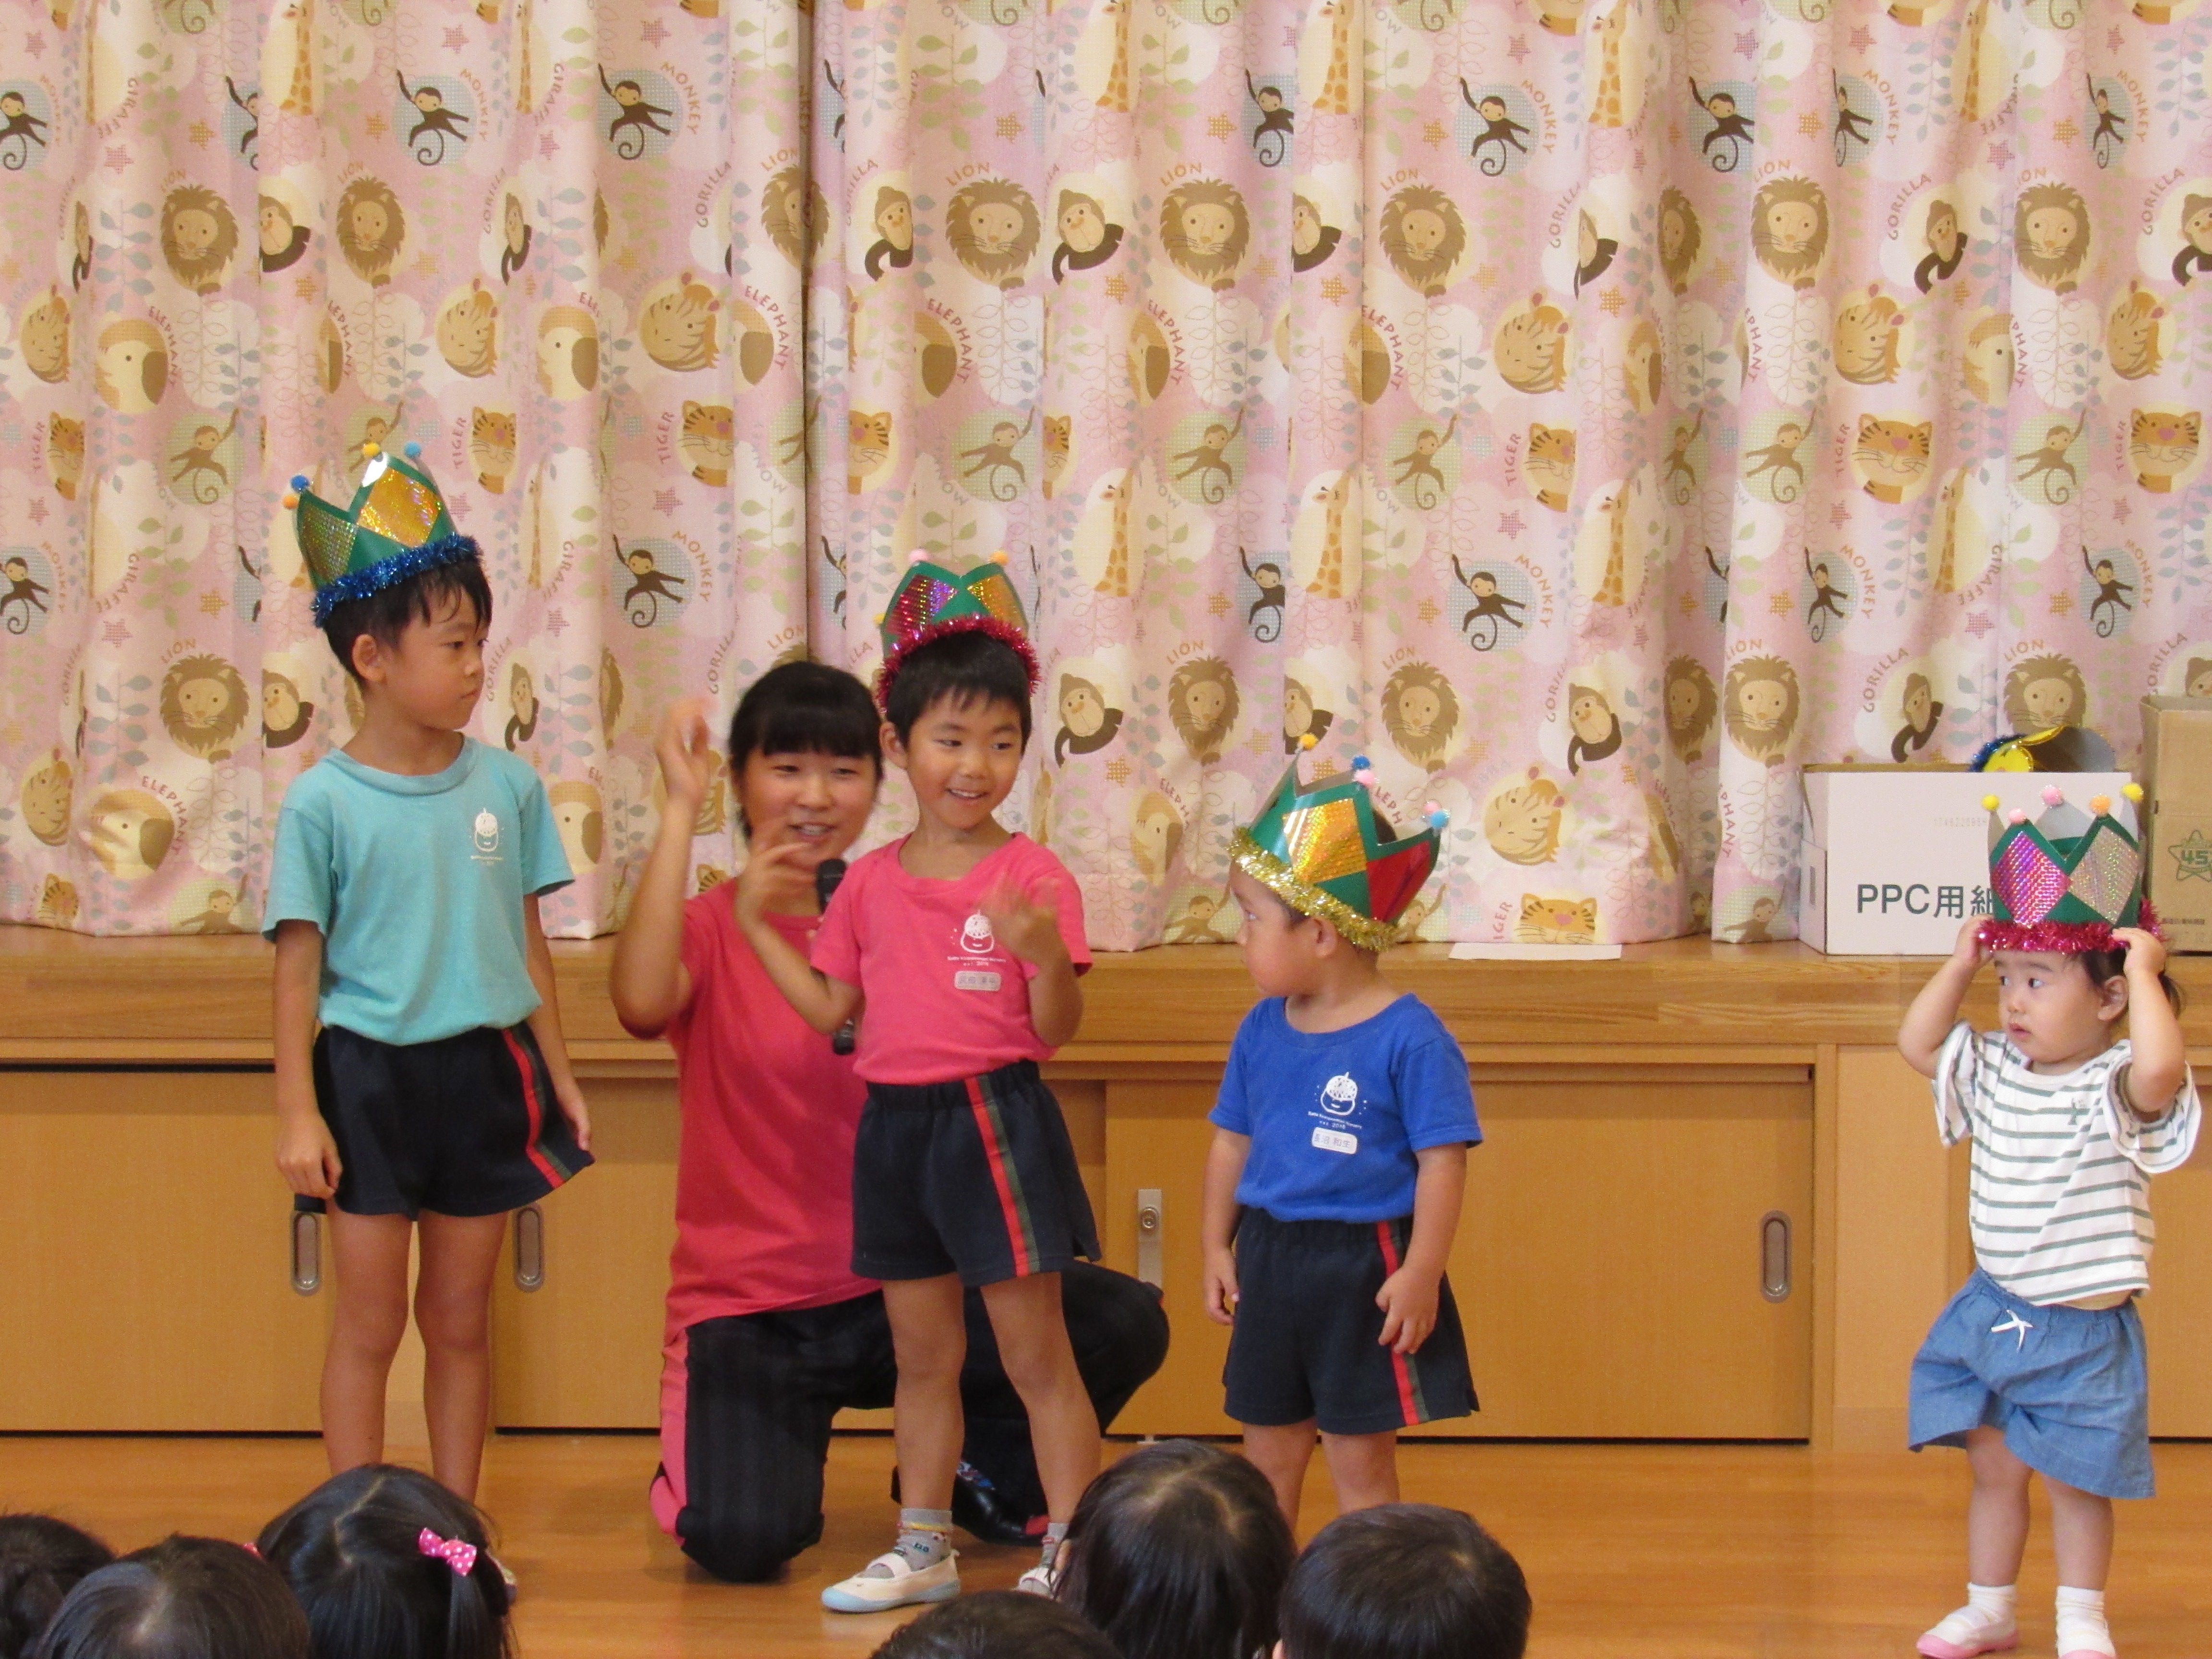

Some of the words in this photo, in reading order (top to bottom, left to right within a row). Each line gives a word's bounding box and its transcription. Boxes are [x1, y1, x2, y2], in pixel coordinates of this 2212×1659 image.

[96, 77, 141, 139] GIRAFFE
[459, 68, 488, 142] MONKEY
[661, 61, 702, 135] MONKEY
[1521, 79, 1557, 154] MONKEY
[1863, 69, 1899, 146] MONKEY
[2116, 70, 2150, 143] MONKEY
[161, 168, 187, 193] LION
[338, 161, 363, 184] LION
[483, 168, 505, 234] GORILLA
[696, 161, 732, 228] GORILLA
[845, 159, 878, 227] GORILLA
[945, 162, 990, 187] LION
[1160, 163, 1202, 186] LION
[1381, 168, 1419, 192] LION
[2141, 168, 2184, 235] GORILLA
[1888, 174, 1932, 240] GORILLA
[745, 286, 789, 371] ELEPHANT
[927, 298, 973, 383] ELEPHANT
[1148, 300, 1186, 385] ELEPHANT
[1361, 304, 1404, 391] ELEPHANT
[2011, 321, 2029, 387] PHANT
[454, 417, 467, 469] TIGER
[659, 411, 674, 464] TIGER
[1506, 433, 1521, 487] TIGER
[1835, 423, 1850, 477] TIGER
[2116, 420, 2127, 470] TIGER
[41, 542, 65, 613] MONKEY
[96, 552, 141, 613] GIRAFFE
[543, 540, 573, 601] GIRAFFE
[673, 530, 713, 602] MONKEY
[1515, 554, 1553, 628] MONKEY
[1840, 545, 1875, 618] MONKEY
[1958, 543, 2002, 606] GIRAFFE
[2124, 539, 2153, 609] MONKEY
[160, 638, 197, 664] LION
[486, 637, 512, 702] GORILLA
[1166, 640, 1205, 665] LION
[1382, 647, 1416, 671] LION
[1863, 648, 1909, 713] GORILLA
[2004, 639, 2044, 662] LION
[142, 776, 187, 855] ELEPHANT
[1375, 786, 1402, 825] LEPH
[1493, 901, 1513, 940] IGER
